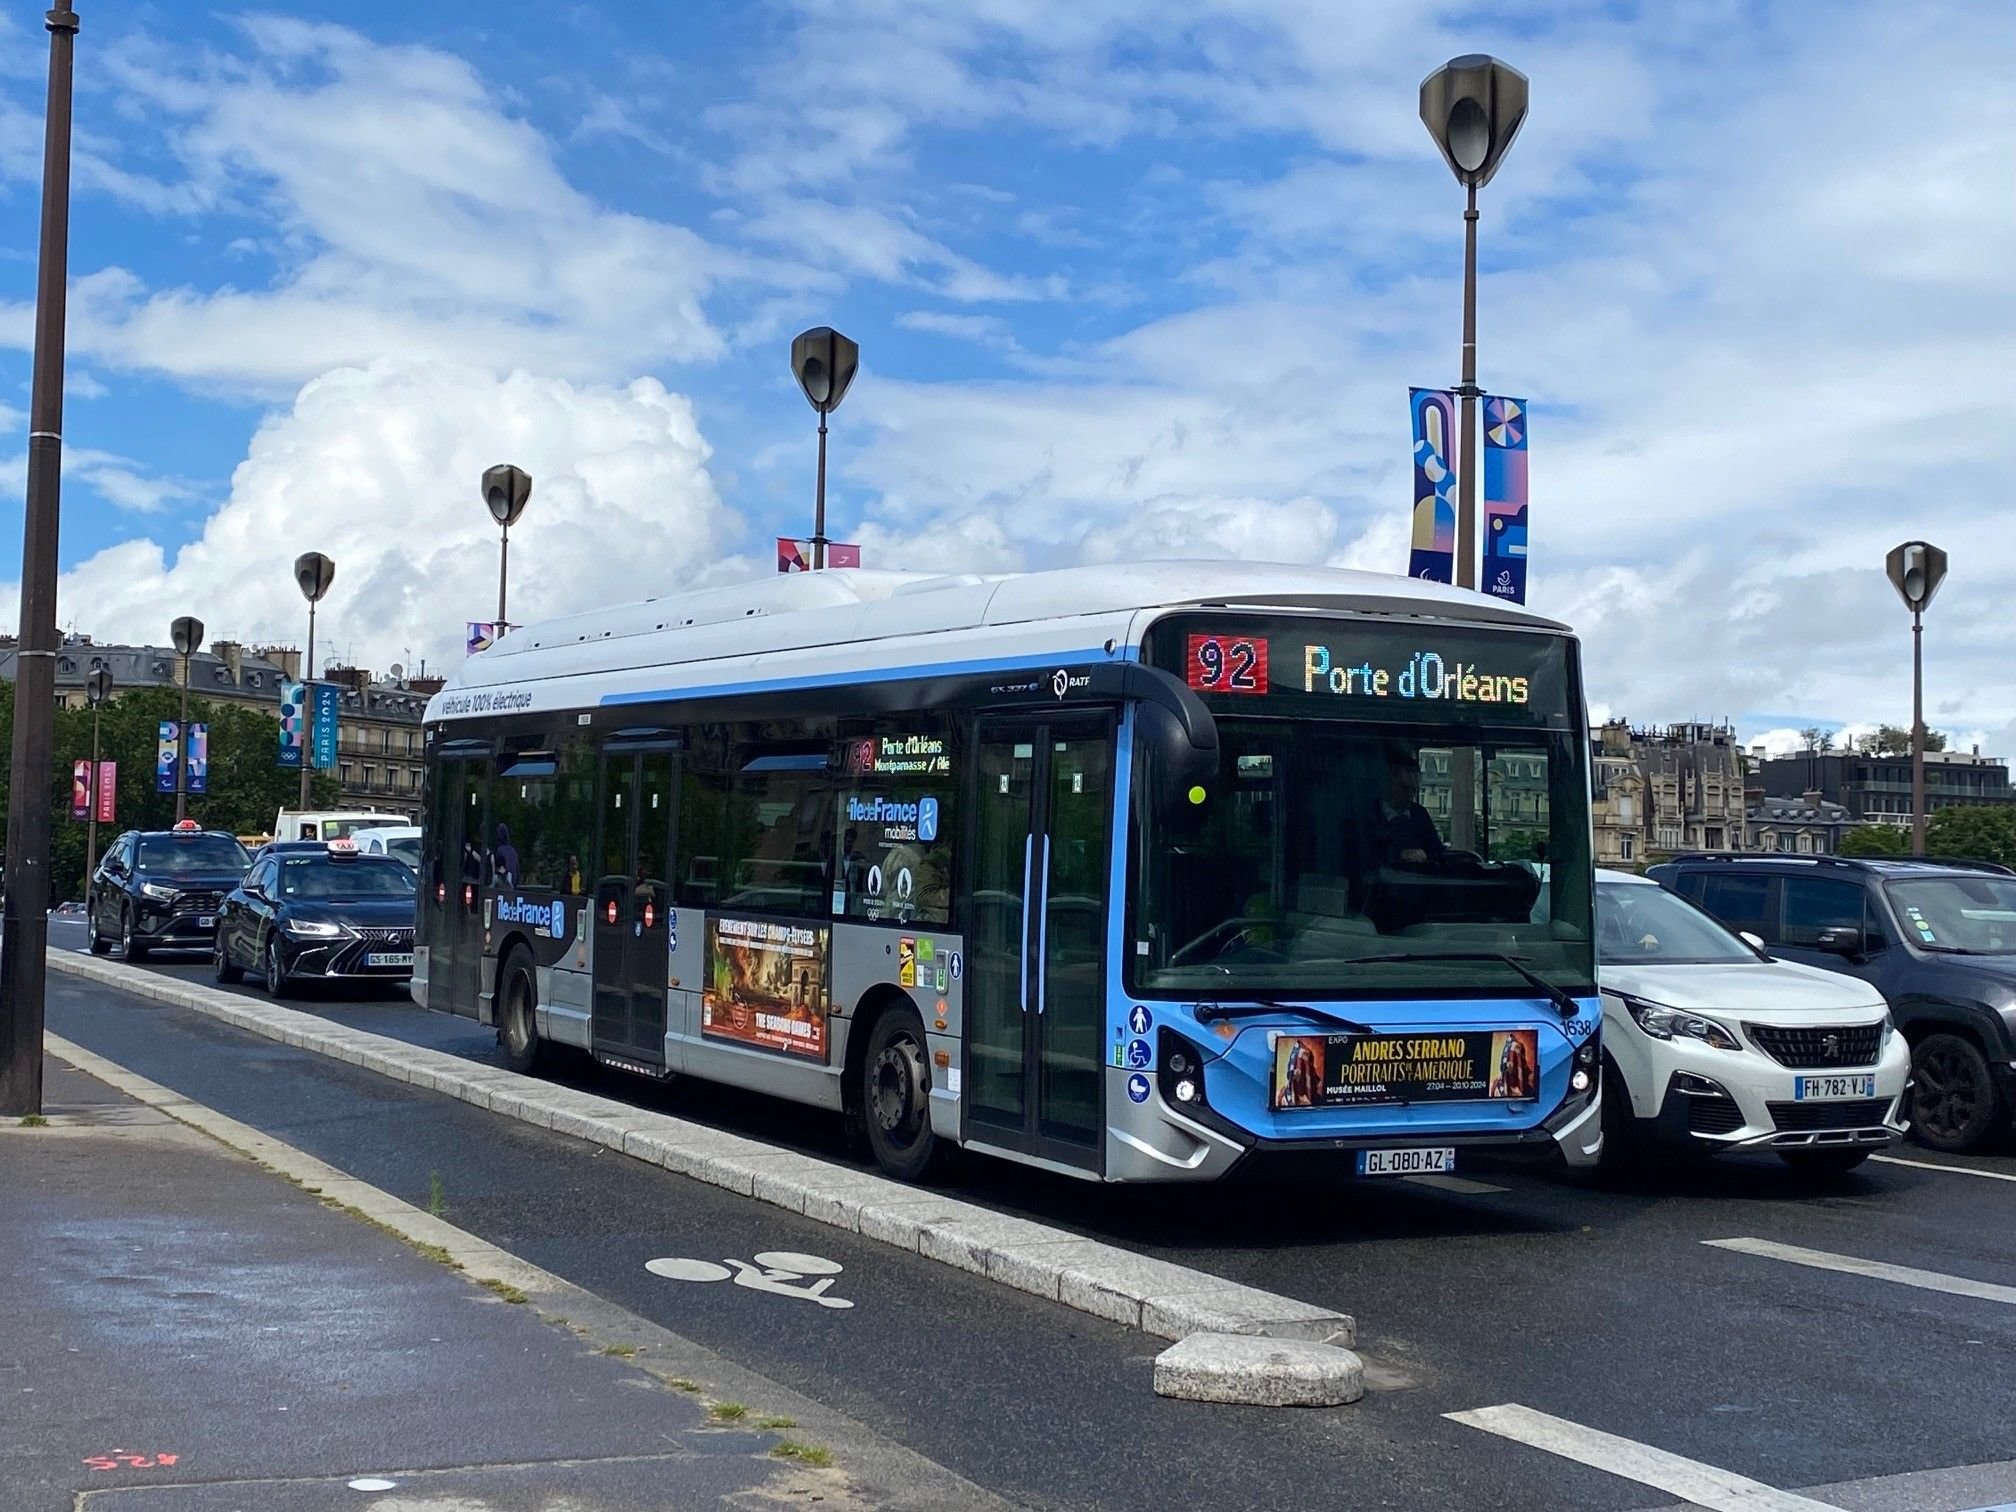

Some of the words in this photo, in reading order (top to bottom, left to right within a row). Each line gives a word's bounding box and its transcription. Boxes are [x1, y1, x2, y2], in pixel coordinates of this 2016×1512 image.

[1492, 585, 1515, 595] PARIS
[1198, 639, 1257, 689] 92
[1304, 645, 1390, 696] Porte
[1398, 651, 1528, 703] d'Orléans
[321, 691, 332, 723] 2024
[441, 696, 472, 716] véhicule
[471, 692, 493, 713] 100%
[492, 690, 533, 712] électrique
[320, 726, 331, 762] PARIS
[882, 737, 904, 755] Porte
[905, 735, 943, 754] d'Orléans
[1560, 1019, 1592, 1036] 1638
[1328, 1035, 1348, 1045] EXPO
[1352, 1040, 1404, 1062] ANDRES
[1405, 1038, 1466, 1060] SERRANO
[1340, 1062, 1406, 1085] PORTRAITS
[1469, 1080, 1487, 1090] 2024
[1326, 1084, 1353, 1095] MUSÉE
[1353, 1083, 1387, 1094] MAILLOL
[1804, 1078, 1866, 1097] FH-782-VJ
[1368, 1149, 1444, 1173] GL-080-AZ
